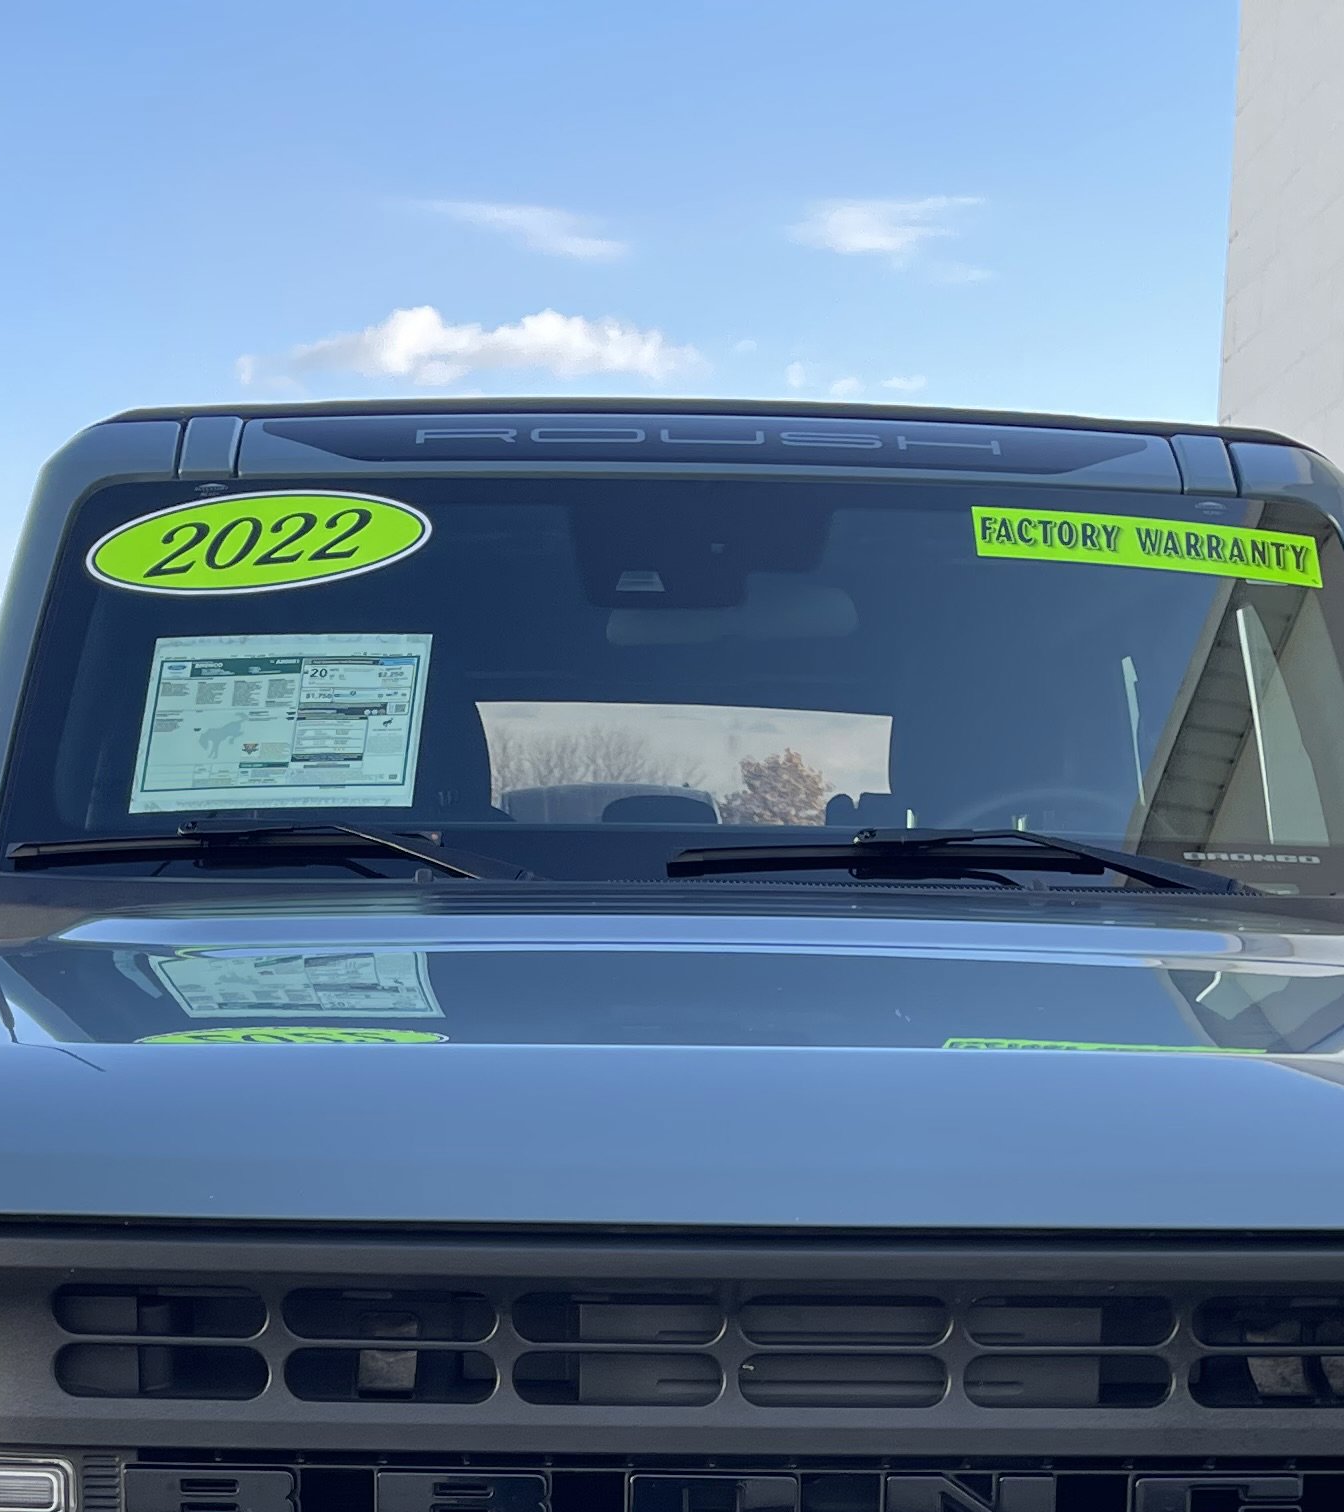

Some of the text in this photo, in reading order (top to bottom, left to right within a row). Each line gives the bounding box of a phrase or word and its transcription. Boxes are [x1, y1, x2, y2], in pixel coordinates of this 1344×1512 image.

[414, 427, 1003, 456] ROUSH
[142, 507, 373, 579] 2022
[979, 515, 1311, 574] FACTORY WARRANTY
[309, 668, 328, 678] 20
[1183, 851, 1321, 864] BRONCO
